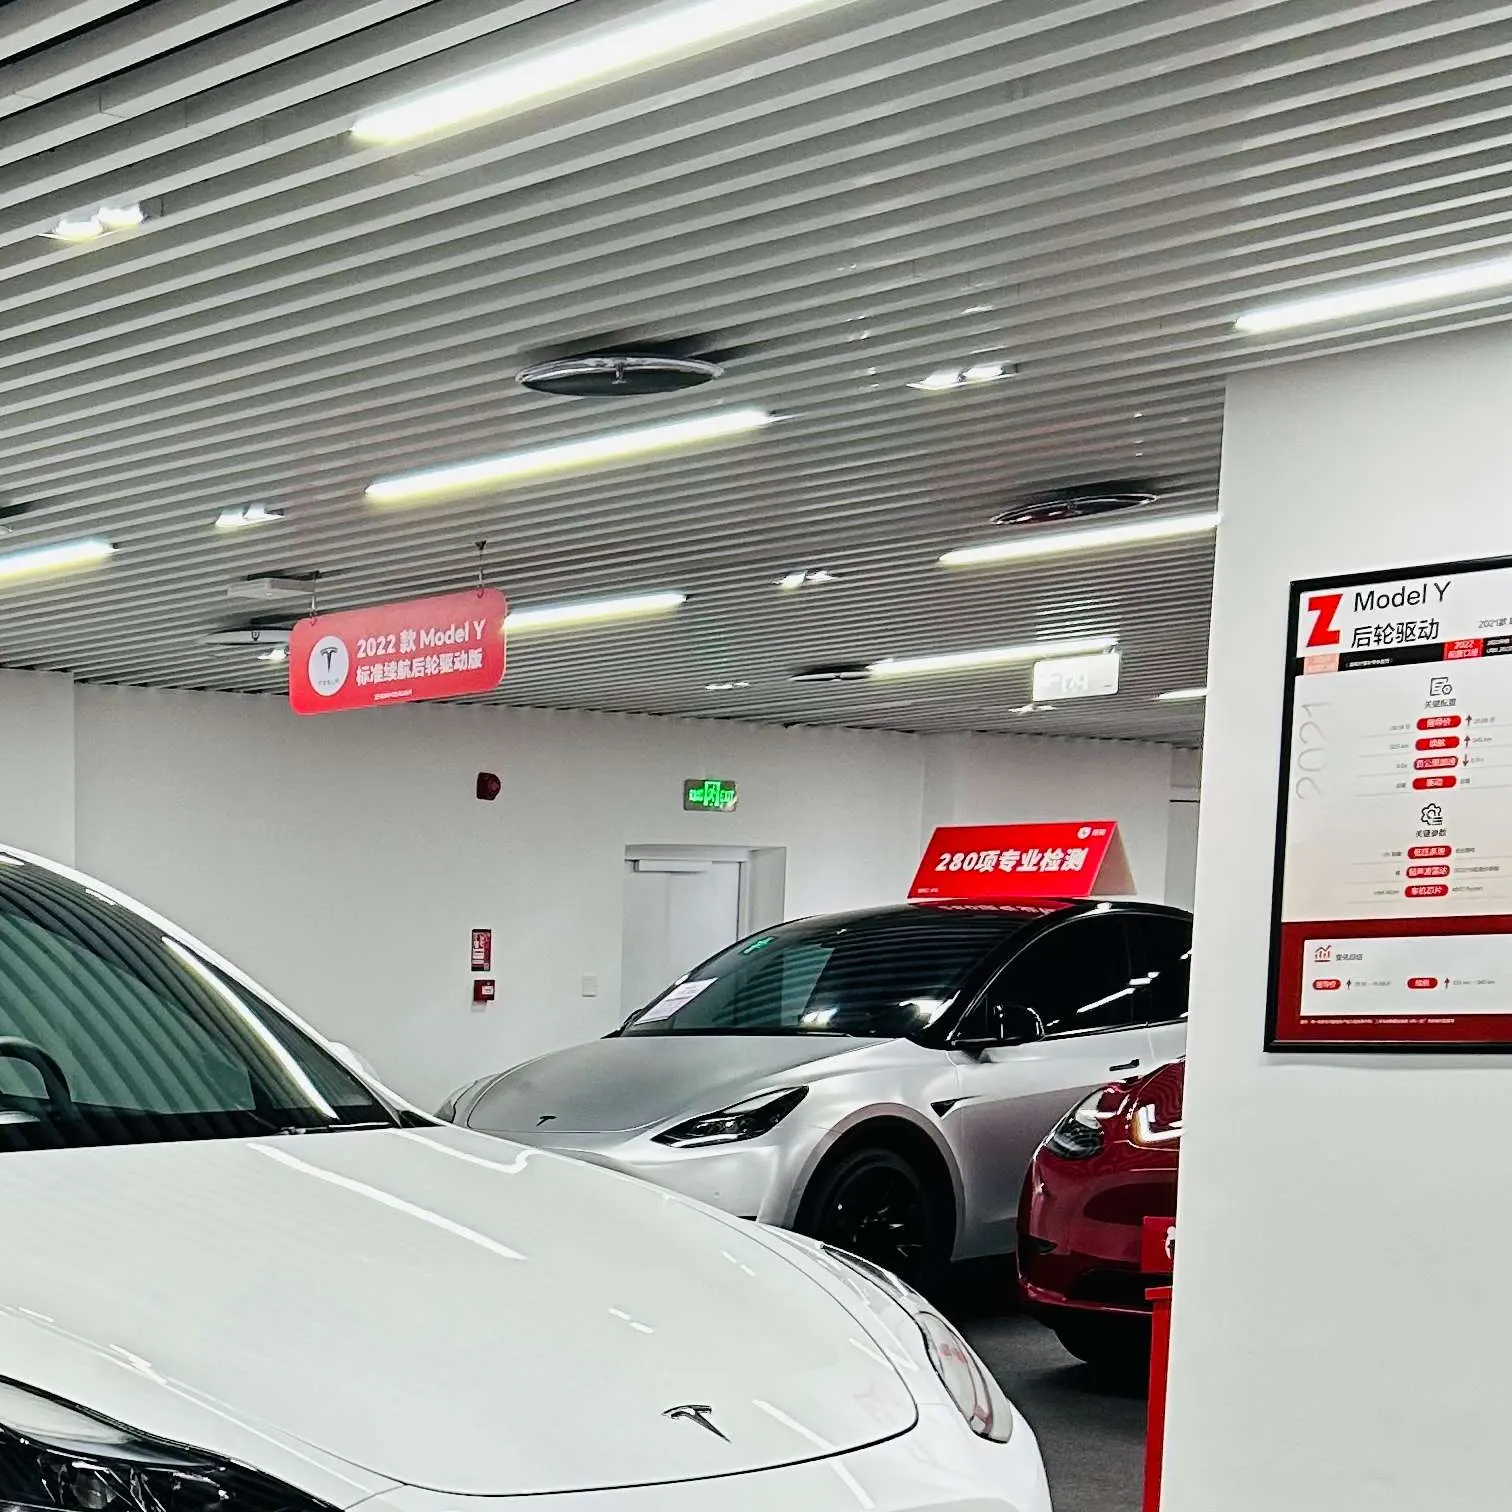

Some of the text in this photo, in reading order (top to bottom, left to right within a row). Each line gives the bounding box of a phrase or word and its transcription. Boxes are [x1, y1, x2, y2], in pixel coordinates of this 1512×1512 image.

[1354, 581, 1451, 613] Model Y
[356, 618, 488, 659] 2022 款 Model Y
[1351, 618, 1440, 649] 后轮驱动
[355, 647, 483, 687] 标准续航后轮驱动版
[935, 847, 1090, 873] 280项专业检测
